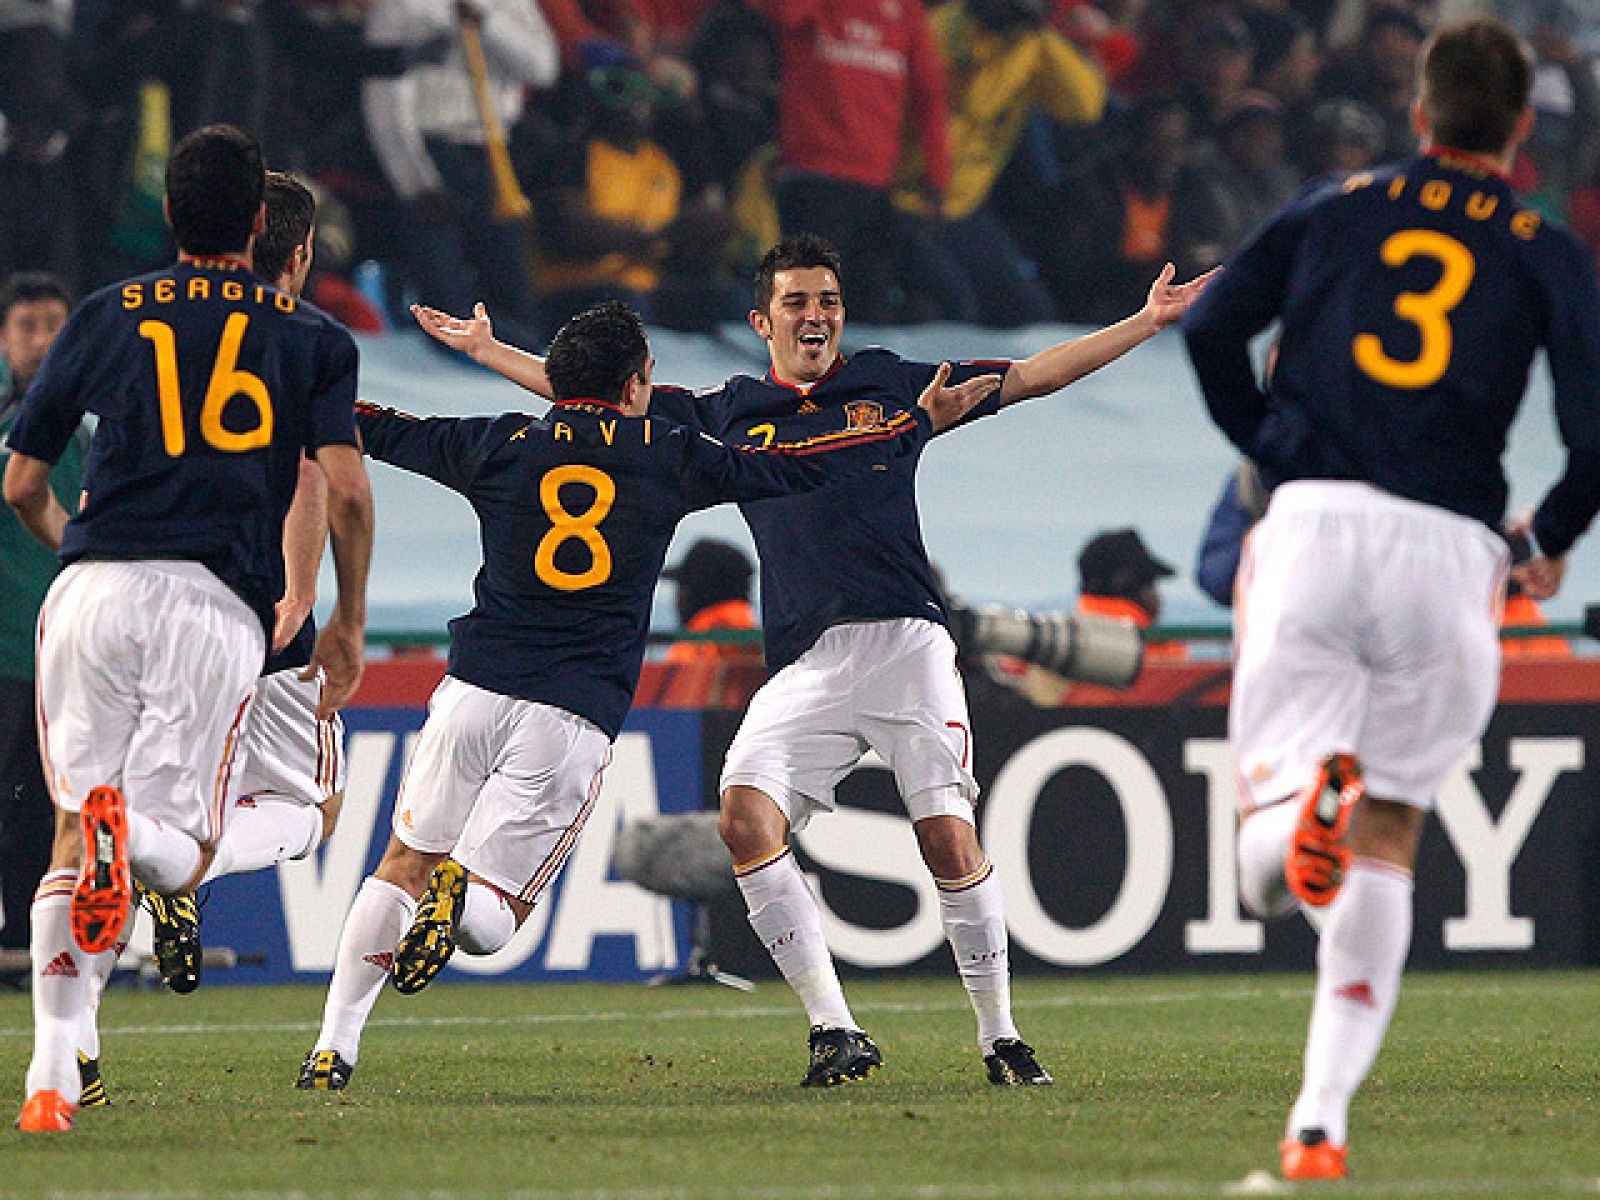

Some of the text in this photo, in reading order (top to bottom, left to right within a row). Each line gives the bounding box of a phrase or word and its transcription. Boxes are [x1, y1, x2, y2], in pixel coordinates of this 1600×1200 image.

[121, 277, 297, 313] SERGIO
[1353, 229, 1476, 390] 3
[138, 312, 275, 457] 16
[746, 422, 776, 450] 7
[534, 464, 616, 592] 8
[945, 721, 968, 768] 7
[266, 733, 678, 972] VA
